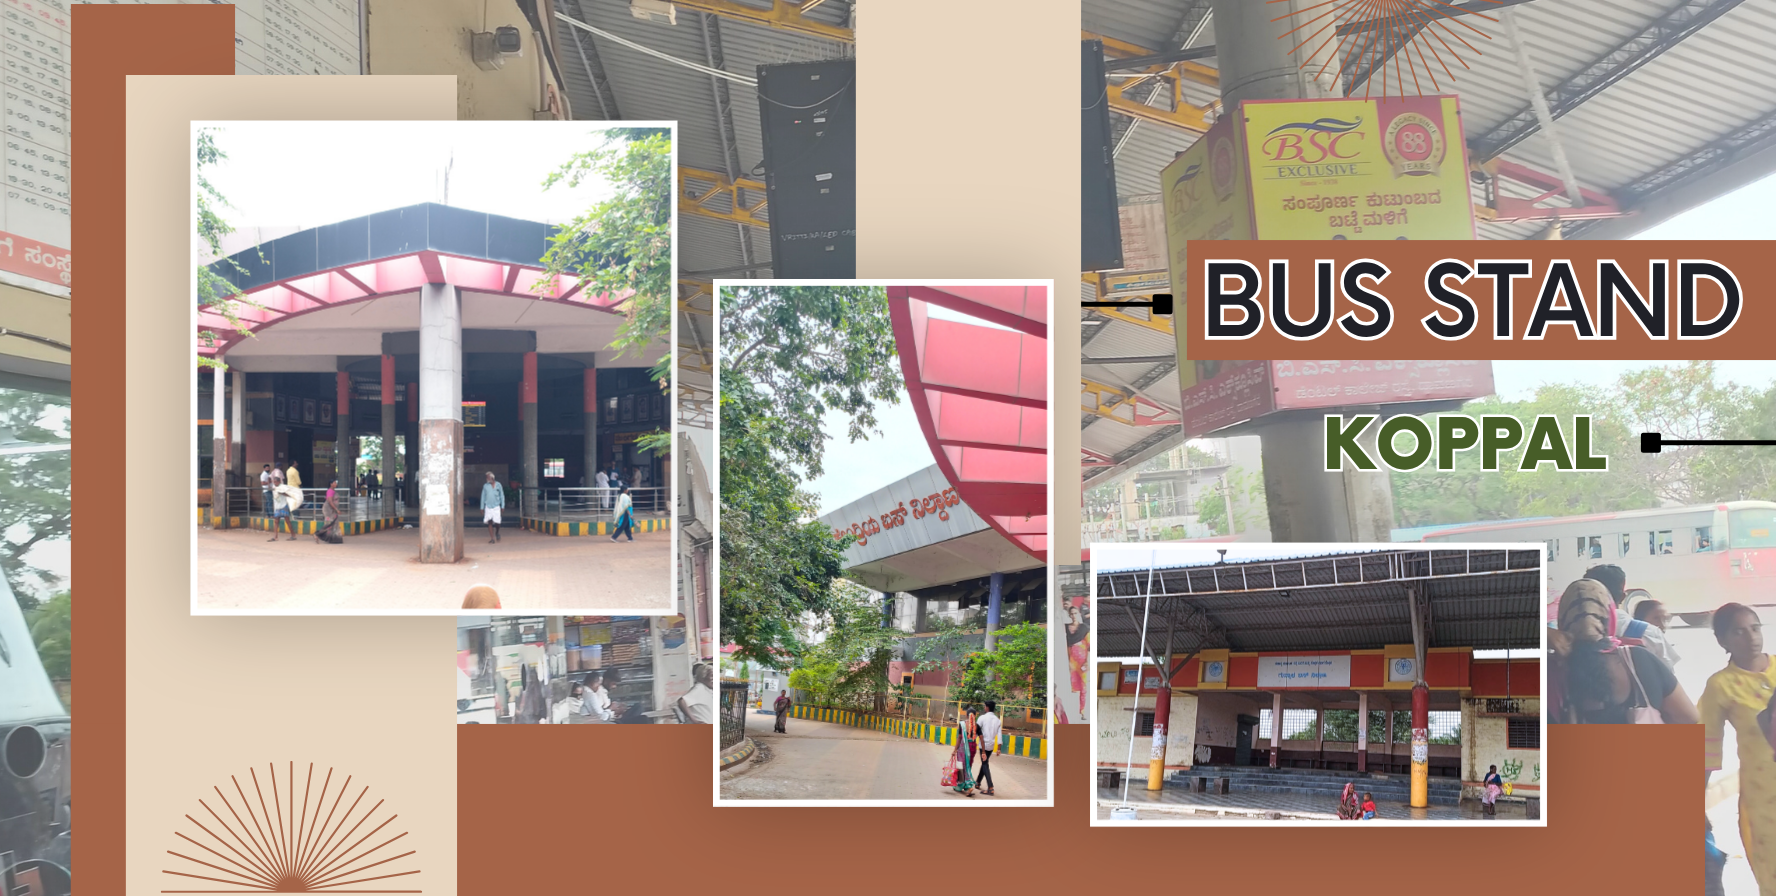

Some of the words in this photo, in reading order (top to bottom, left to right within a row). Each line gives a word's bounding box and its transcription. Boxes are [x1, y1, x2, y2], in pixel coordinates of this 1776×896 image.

[1262, 130, 1366, 164] BSC
[1402, 131, 1427, 154] 88
[1277, 163, 1359, 178] EXCLUSIVE
[1401, 162, 1432, 171] YEARS
[1282, 194, 1359, 213] ಸಂಪೂರ್ಣ
[1366, 189, 1442, 207] ಕುಟುಂಬದ
[881, 502, 908, 530] ಬಸ್
[909, 487, 960, 522] ನಿಲ್ದಾಣ
